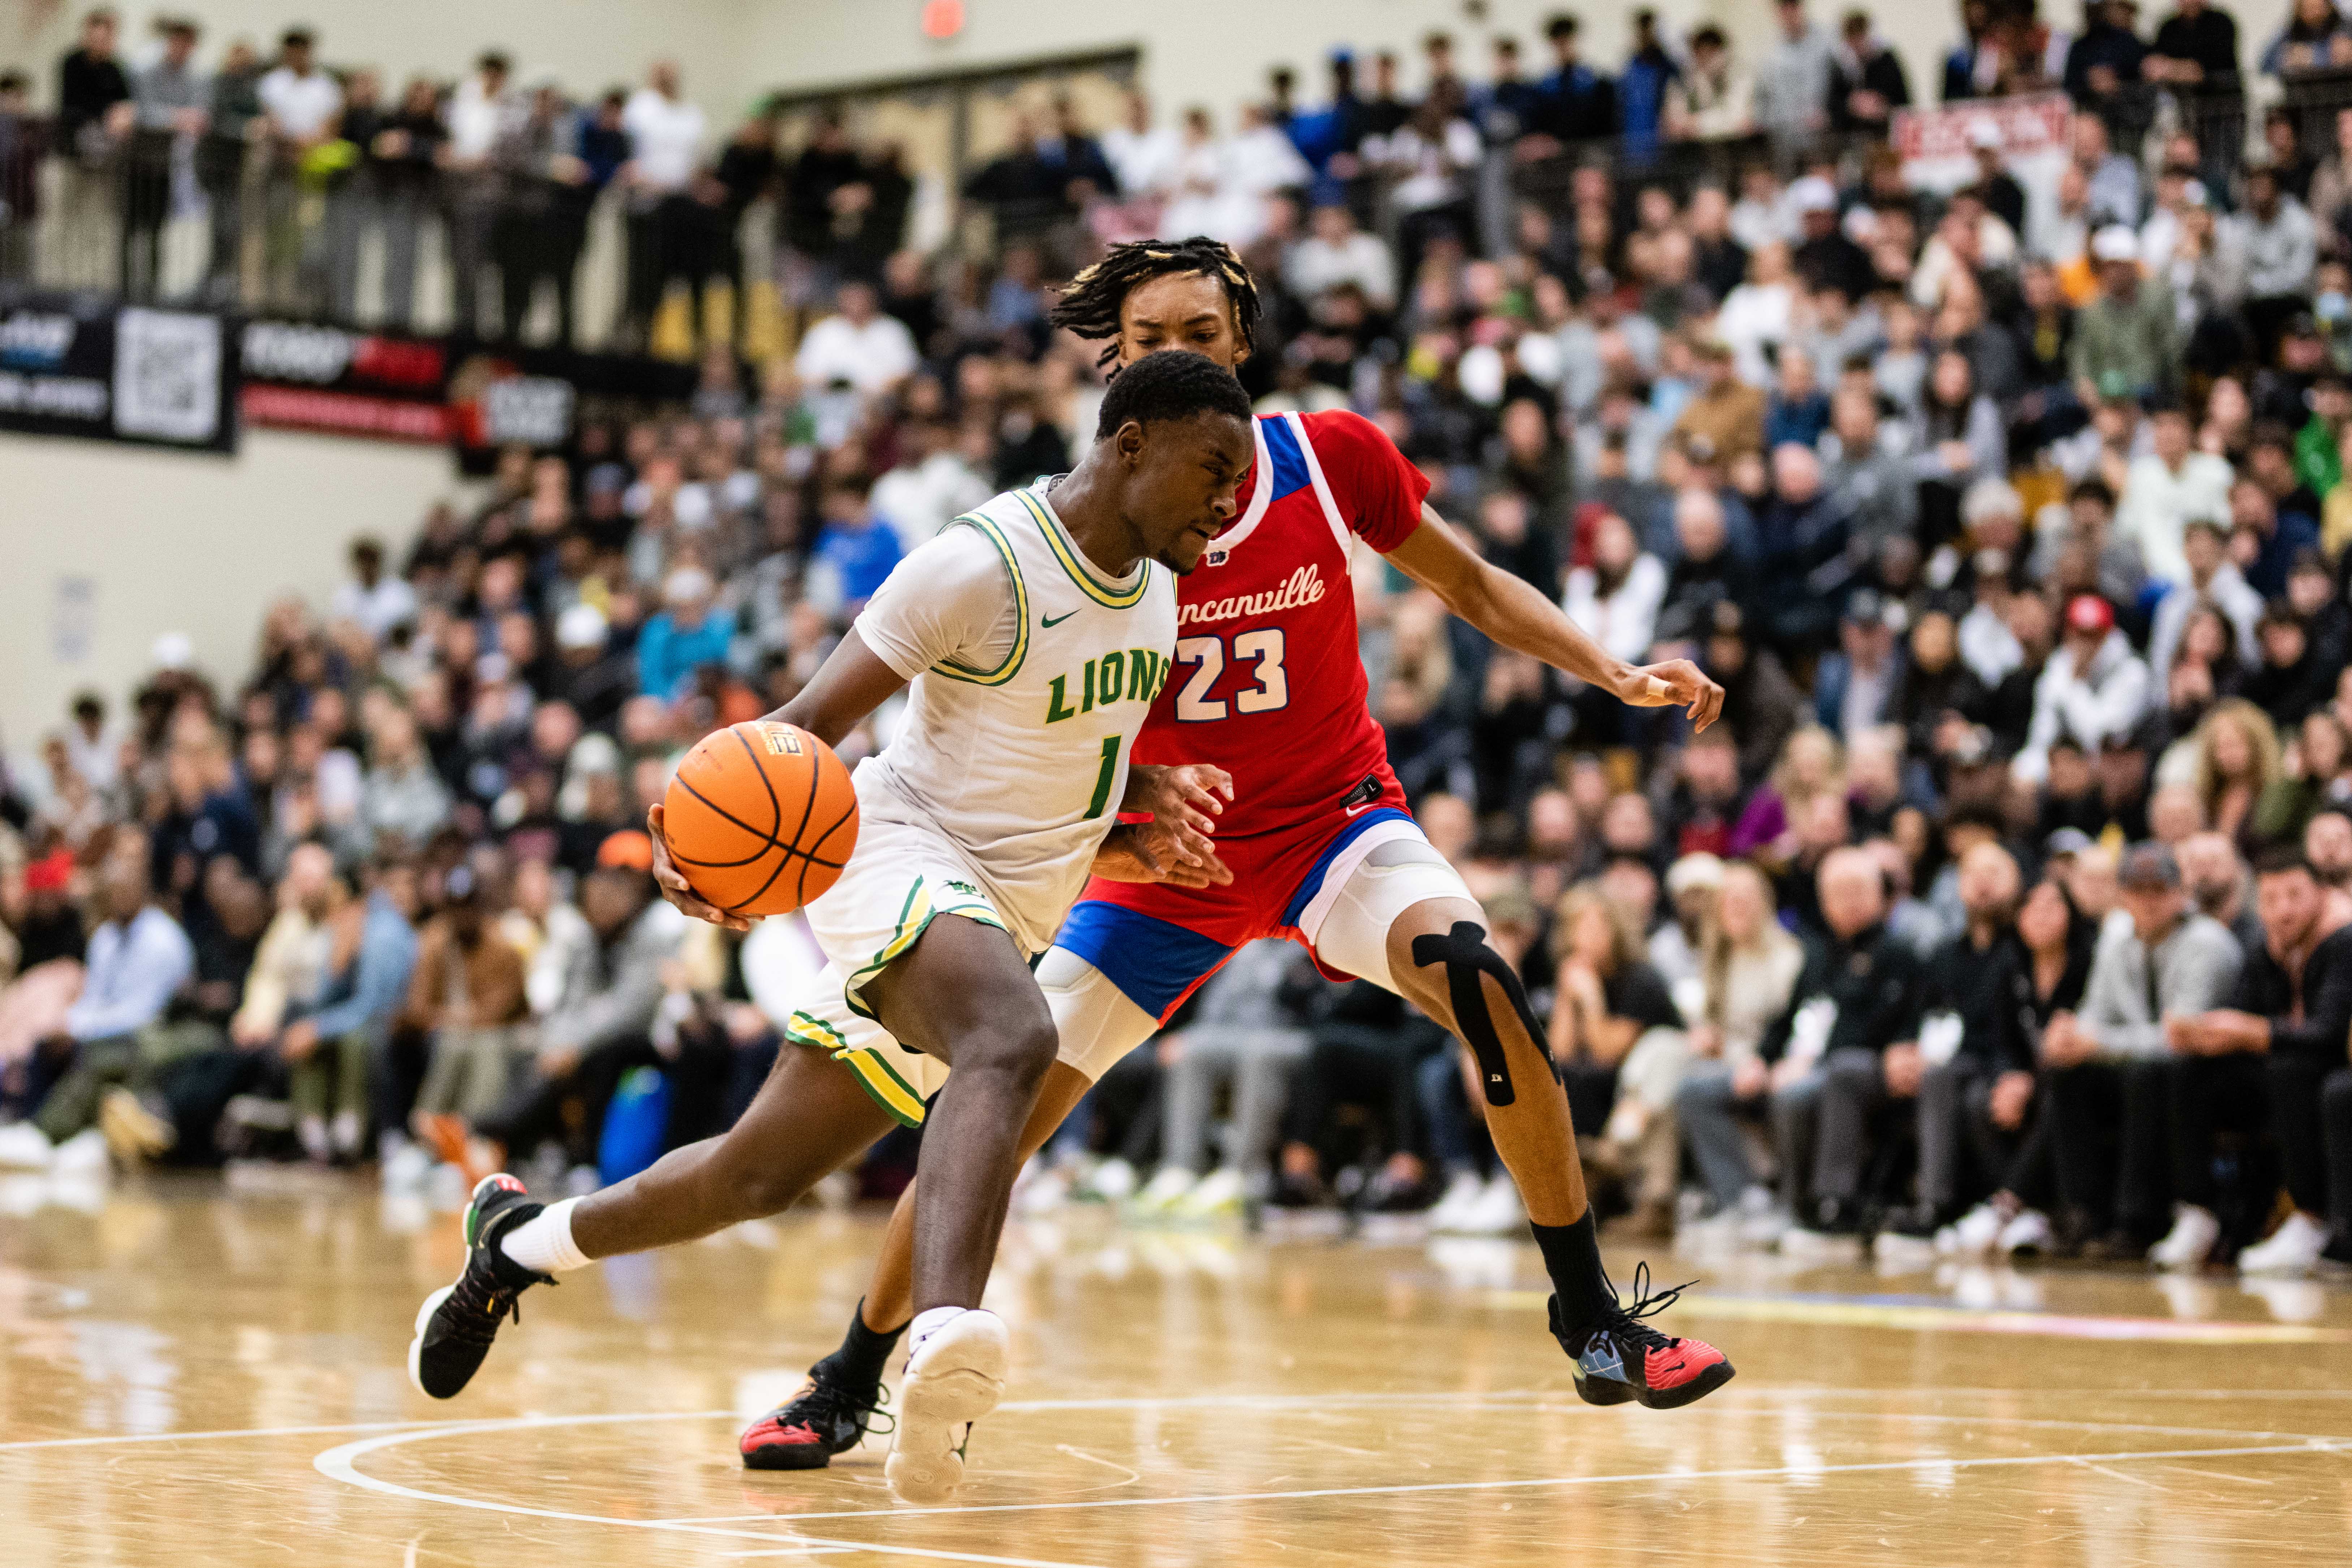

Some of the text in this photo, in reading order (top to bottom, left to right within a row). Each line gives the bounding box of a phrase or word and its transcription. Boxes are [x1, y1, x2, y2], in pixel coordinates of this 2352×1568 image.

[1177, 563, 1325, 625] ncanville
[1175, 626, 1290, 723] 23
[1082, 733, 1122, 819] 1
